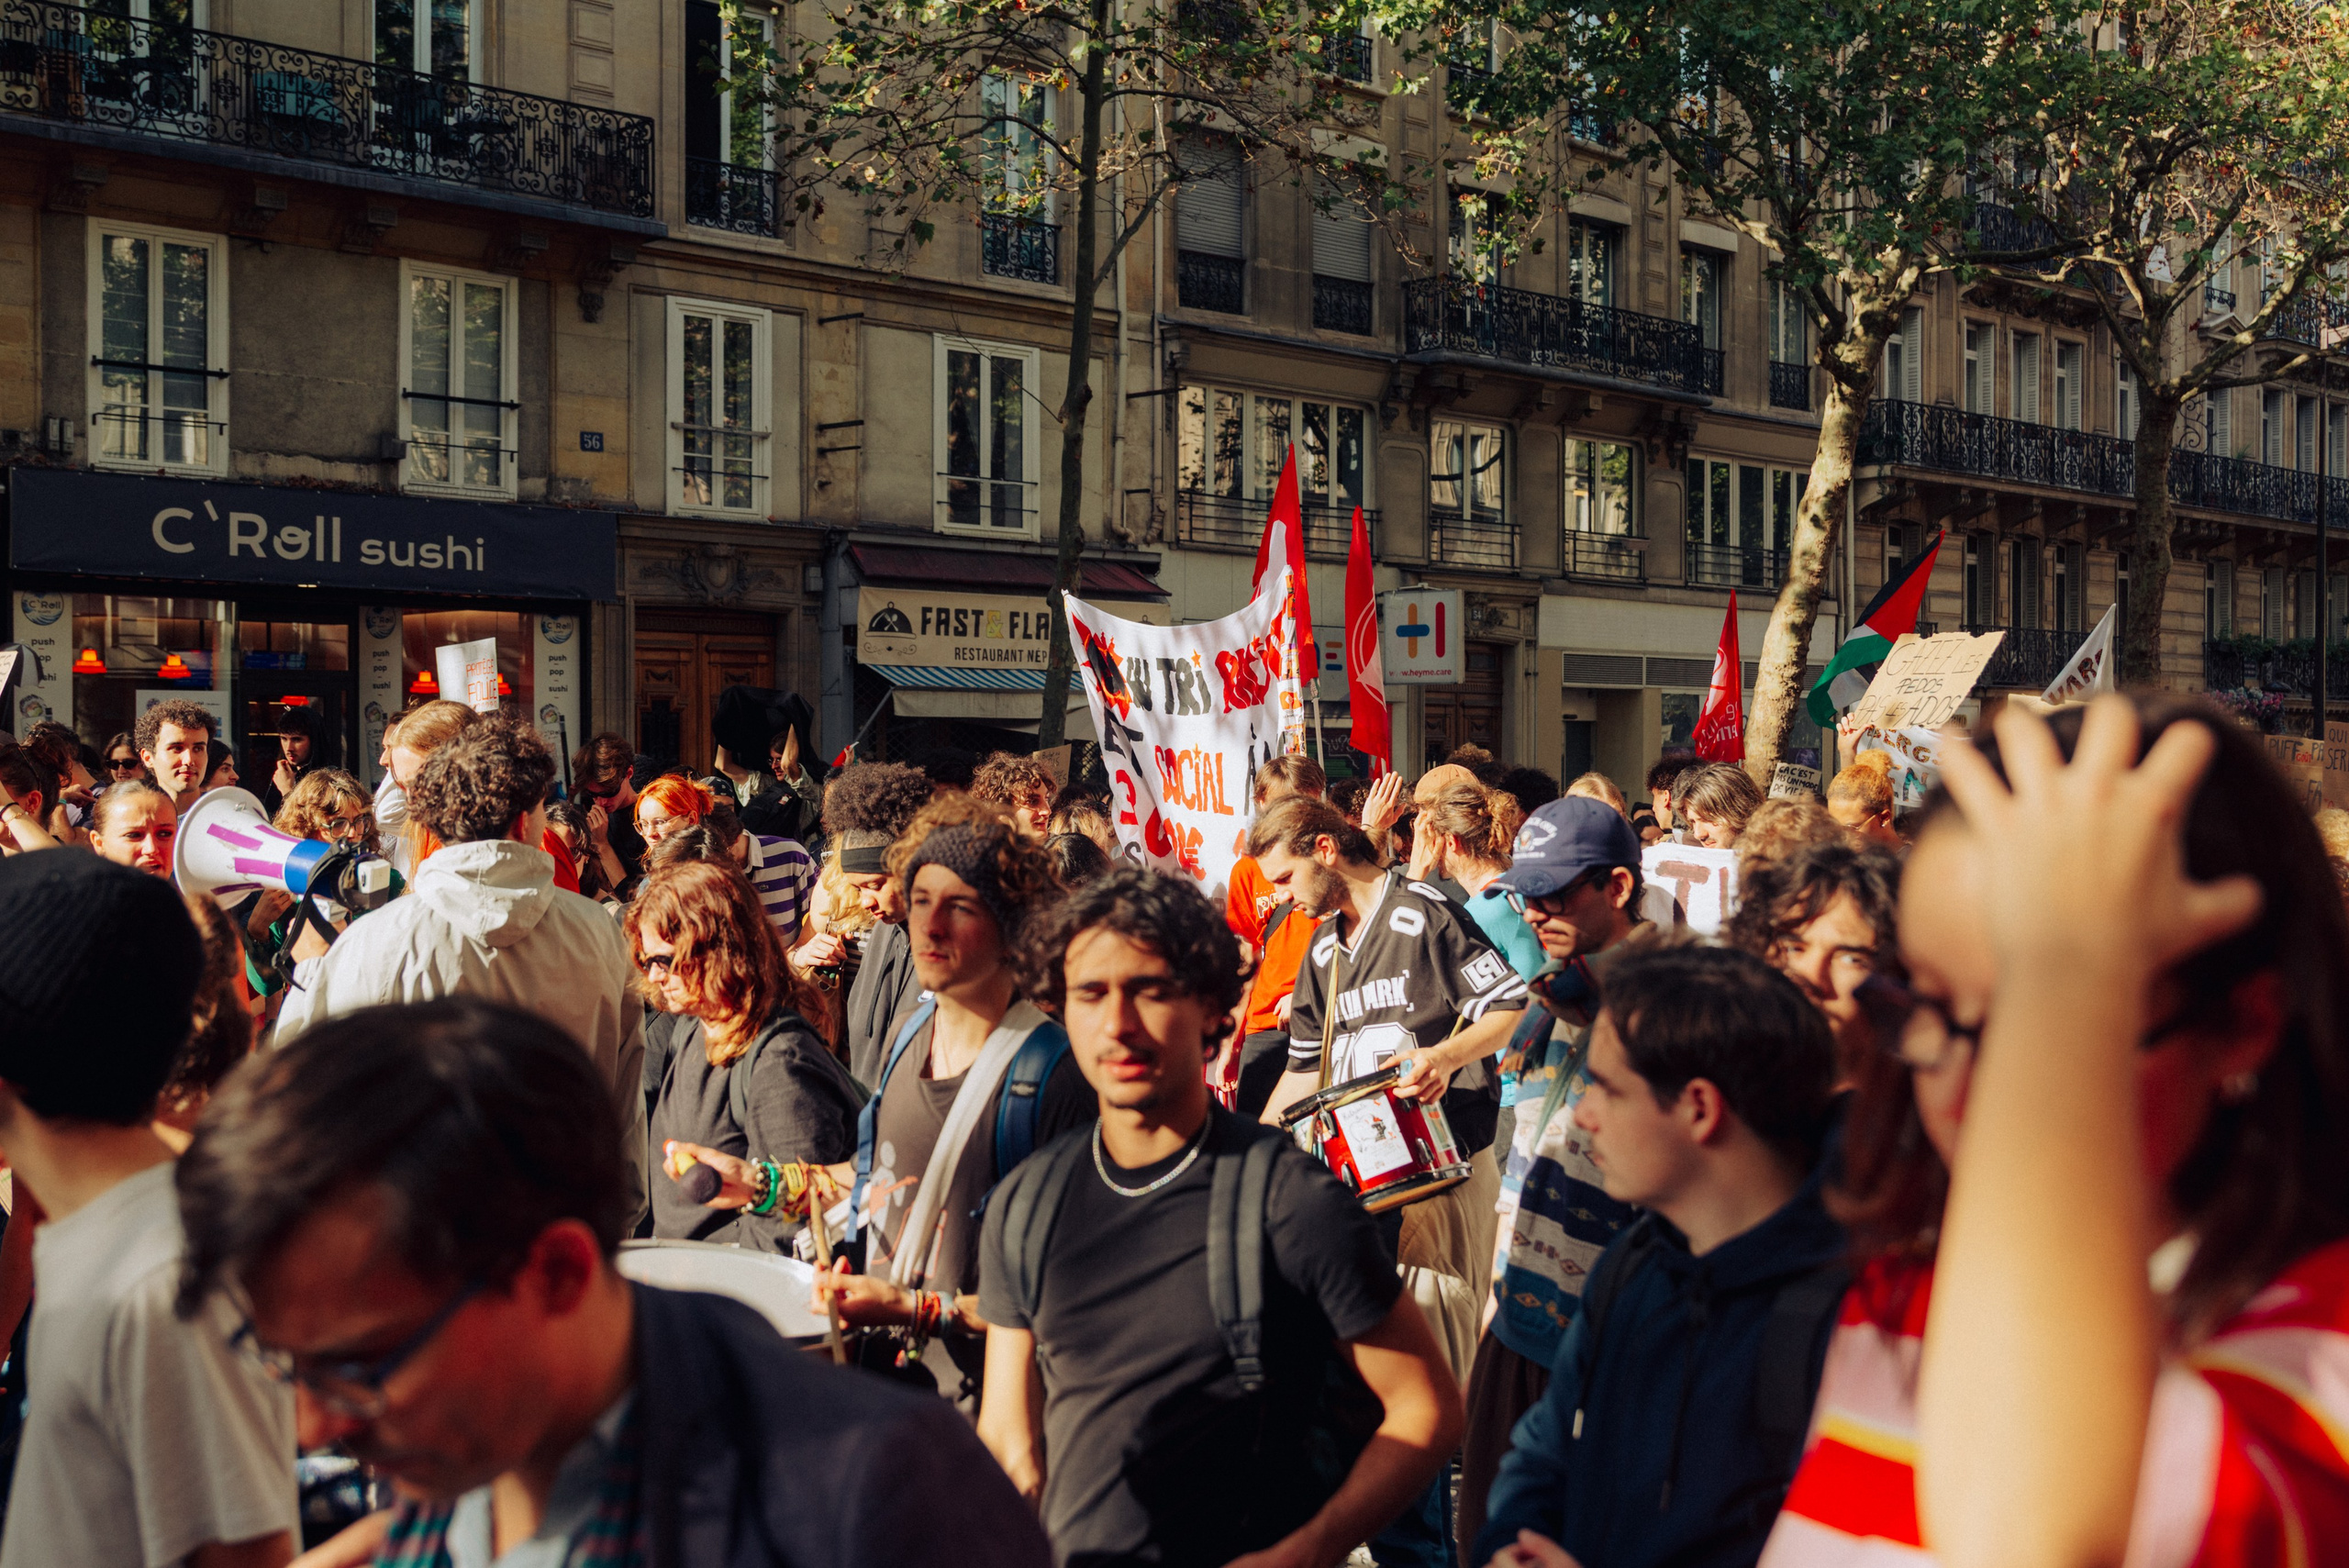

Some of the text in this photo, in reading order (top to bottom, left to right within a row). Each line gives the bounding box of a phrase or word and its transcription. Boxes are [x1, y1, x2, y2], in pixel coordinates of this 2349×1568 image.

[584, 434, 600, 450] 56
[360, 535, 484, 572] sushi
[920, 606, 984, 638] FAST
[985, 609, 1004, 639] &
[31, 638, 55, 647] push
[373, 650, 390, 658] push
[954, 647, 1023, 663] RESTAURANT
[373, 664, 387, 673] pop
[373, 681, 391, 689] sushi
